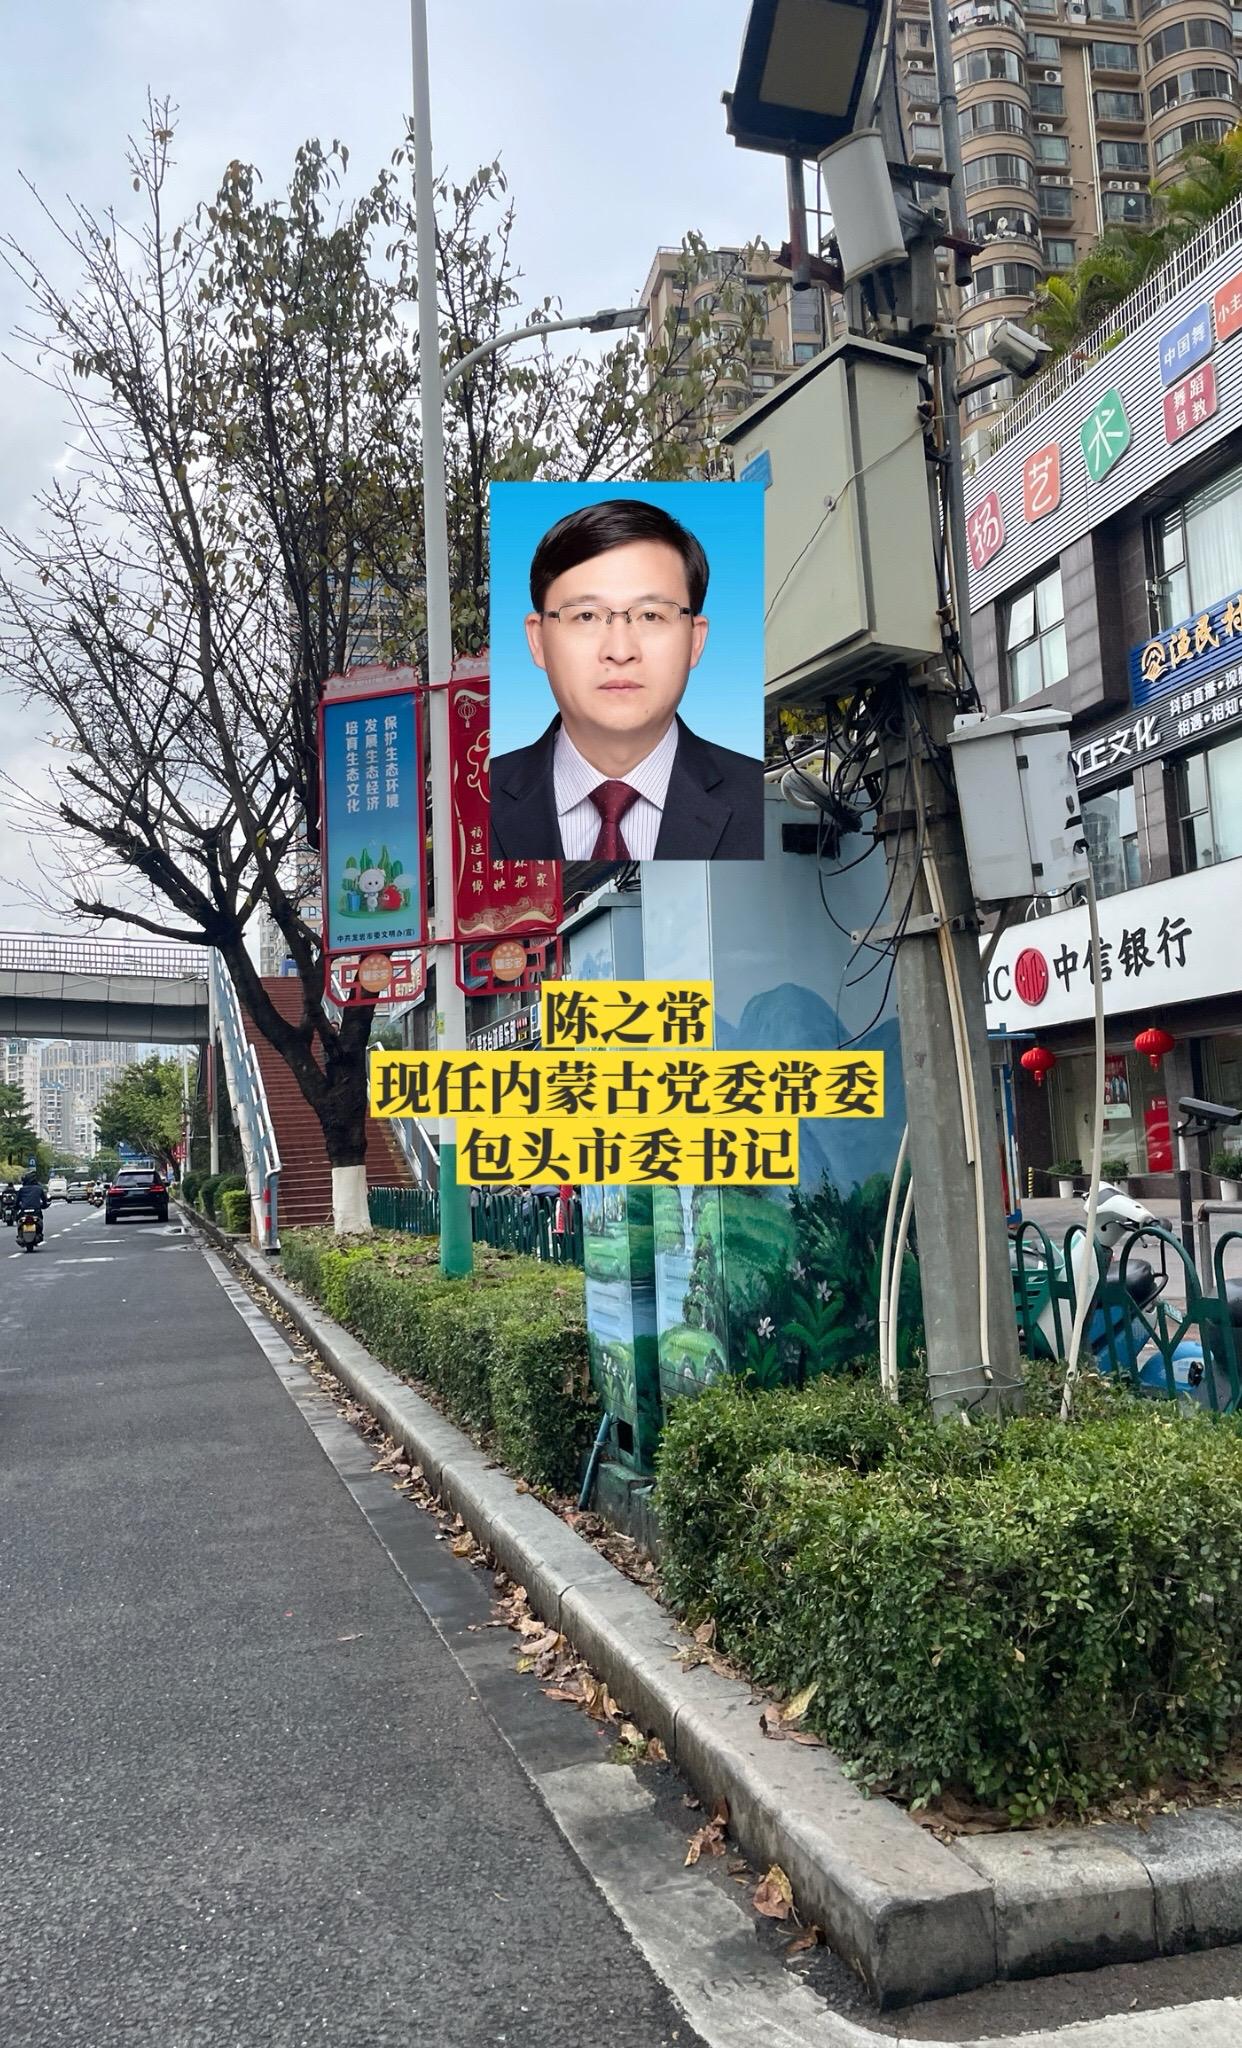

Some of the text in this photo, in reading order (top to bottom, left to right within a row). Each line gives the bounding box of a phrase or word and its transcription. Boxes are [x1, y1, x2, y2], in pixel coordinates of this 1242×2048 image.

[1164, 322, 1206, 367] 中国舞
[1173, 372, 1205, 411] 舞蹈
[1176, 397, 1208, 432] 早教
[345, 720, 360, 813] 培育生态文化
[365, 718, 380, 811] 发展生态经济
[384, 715, 400, 808] 保护生态环境
[1053, 917, 1192, 992] 中信银行
